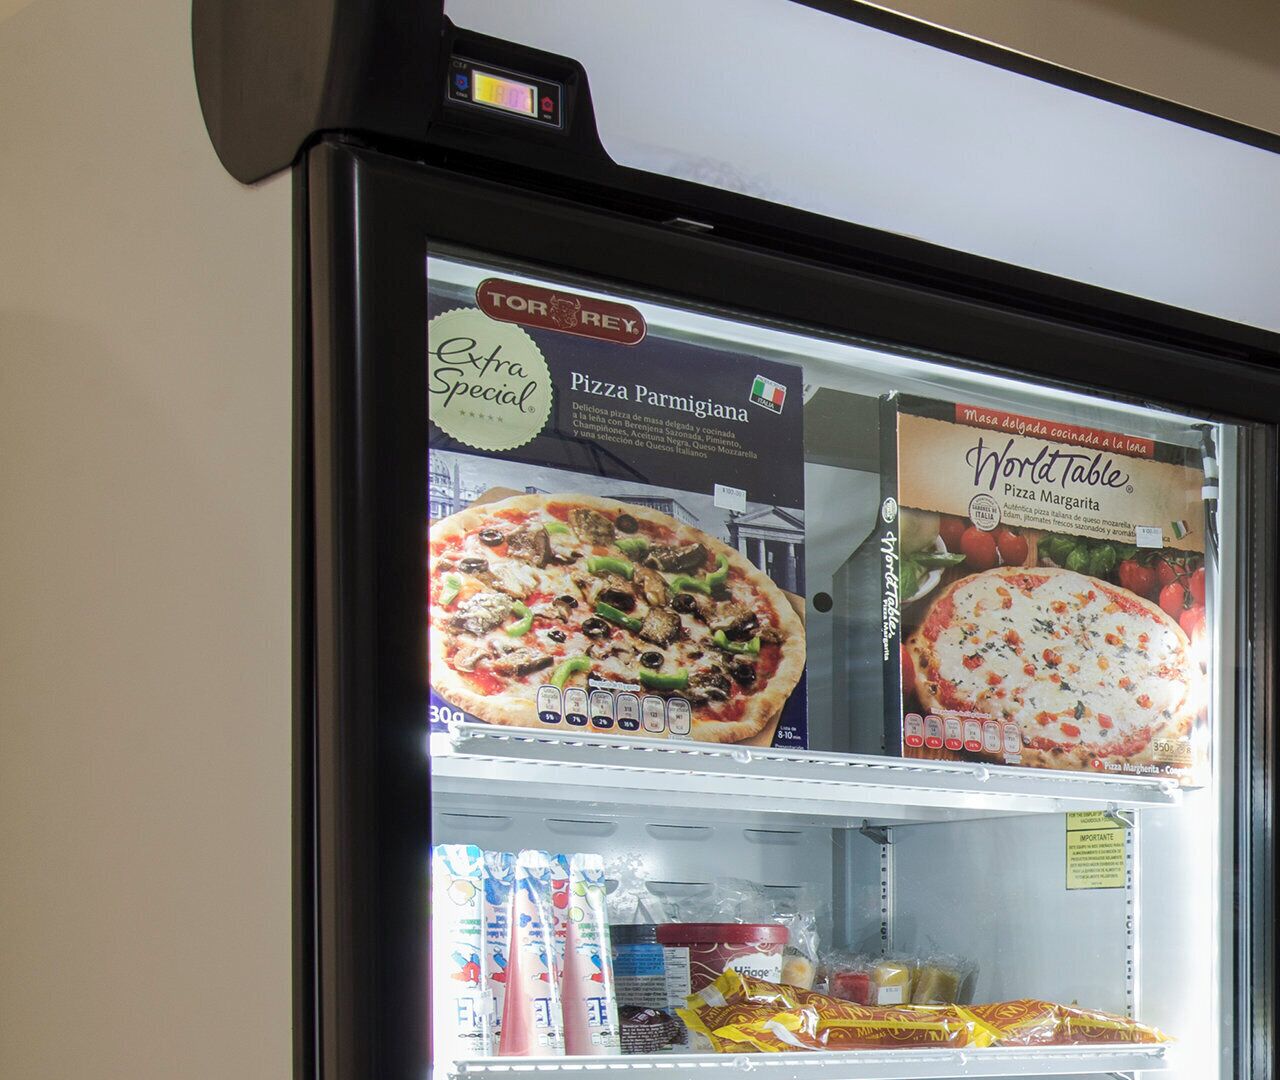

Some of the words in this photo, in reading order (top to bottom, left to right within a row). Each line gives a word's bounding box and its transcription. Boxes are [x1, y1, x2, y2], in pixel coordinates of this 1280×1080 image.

[487, 292, 548, 316] TOR
[428, 367, 537, 413] Special
[570, 372, 629, 401] Pizza
[635, 384, 749, 422] Parmigiana
[573, 402, 609, 416] Deliciosa
[610, 410, 631, 420] pizza
[633, 413, 642, 421] de
[644, 416, 664, 425] masa
[665, 420, 694, 432] delgada
[696, 426, 701, 434] y
[702, 427, 735, 439] cocinada
[579, 412, 587, 420] la
[608, 418, 623, 426] con
[625, 420, 663, 433] Berenjena
[963, 408, 998, 426] Masa
[1002, 416, 1047, 435] delgada
[1051, 427, 1099, 445] cocinada
[1102, 439, 1109, 447] a
[1112, 437, 1124, 449] la
[1126, 439, 1147, 454] leña
[573, 430, 579, 438] y
[581, 431, 595, 439] una
[635, 438, 644, 447] de
[646, 441, 674, 452] Quesos
[675, 446, 708, 459] Italianos
[631, 430, 664, 442] Aceituna
[692, 441, 716, 452] Queso
[718, 446, 758, 459] Mozzarella
[1004, 483, 1036, 501] Pizza
[1040, 489, 1100, 511] Margarita
[975, 510, 994, 521] ITALIA
[1003, 511, 1023, 520] Edam,
[1023, 514, 1051, 527] jitomates
[1052, 517, 1074, 528] frescos
[1075, 521, 1106, 533] sazonados
[1034, 507, 1050, 517] pizza
[1051, 509, 1073, 520] italiana
[1074, 513, 1082, 521] de
[1083, 516, 1101, 526] queso
[1104, 762, 1122, 771] Pizza
[1123, 763, 1160, 775] Margherita
[1080, 833, 1115, 842] IMPORTANTE
